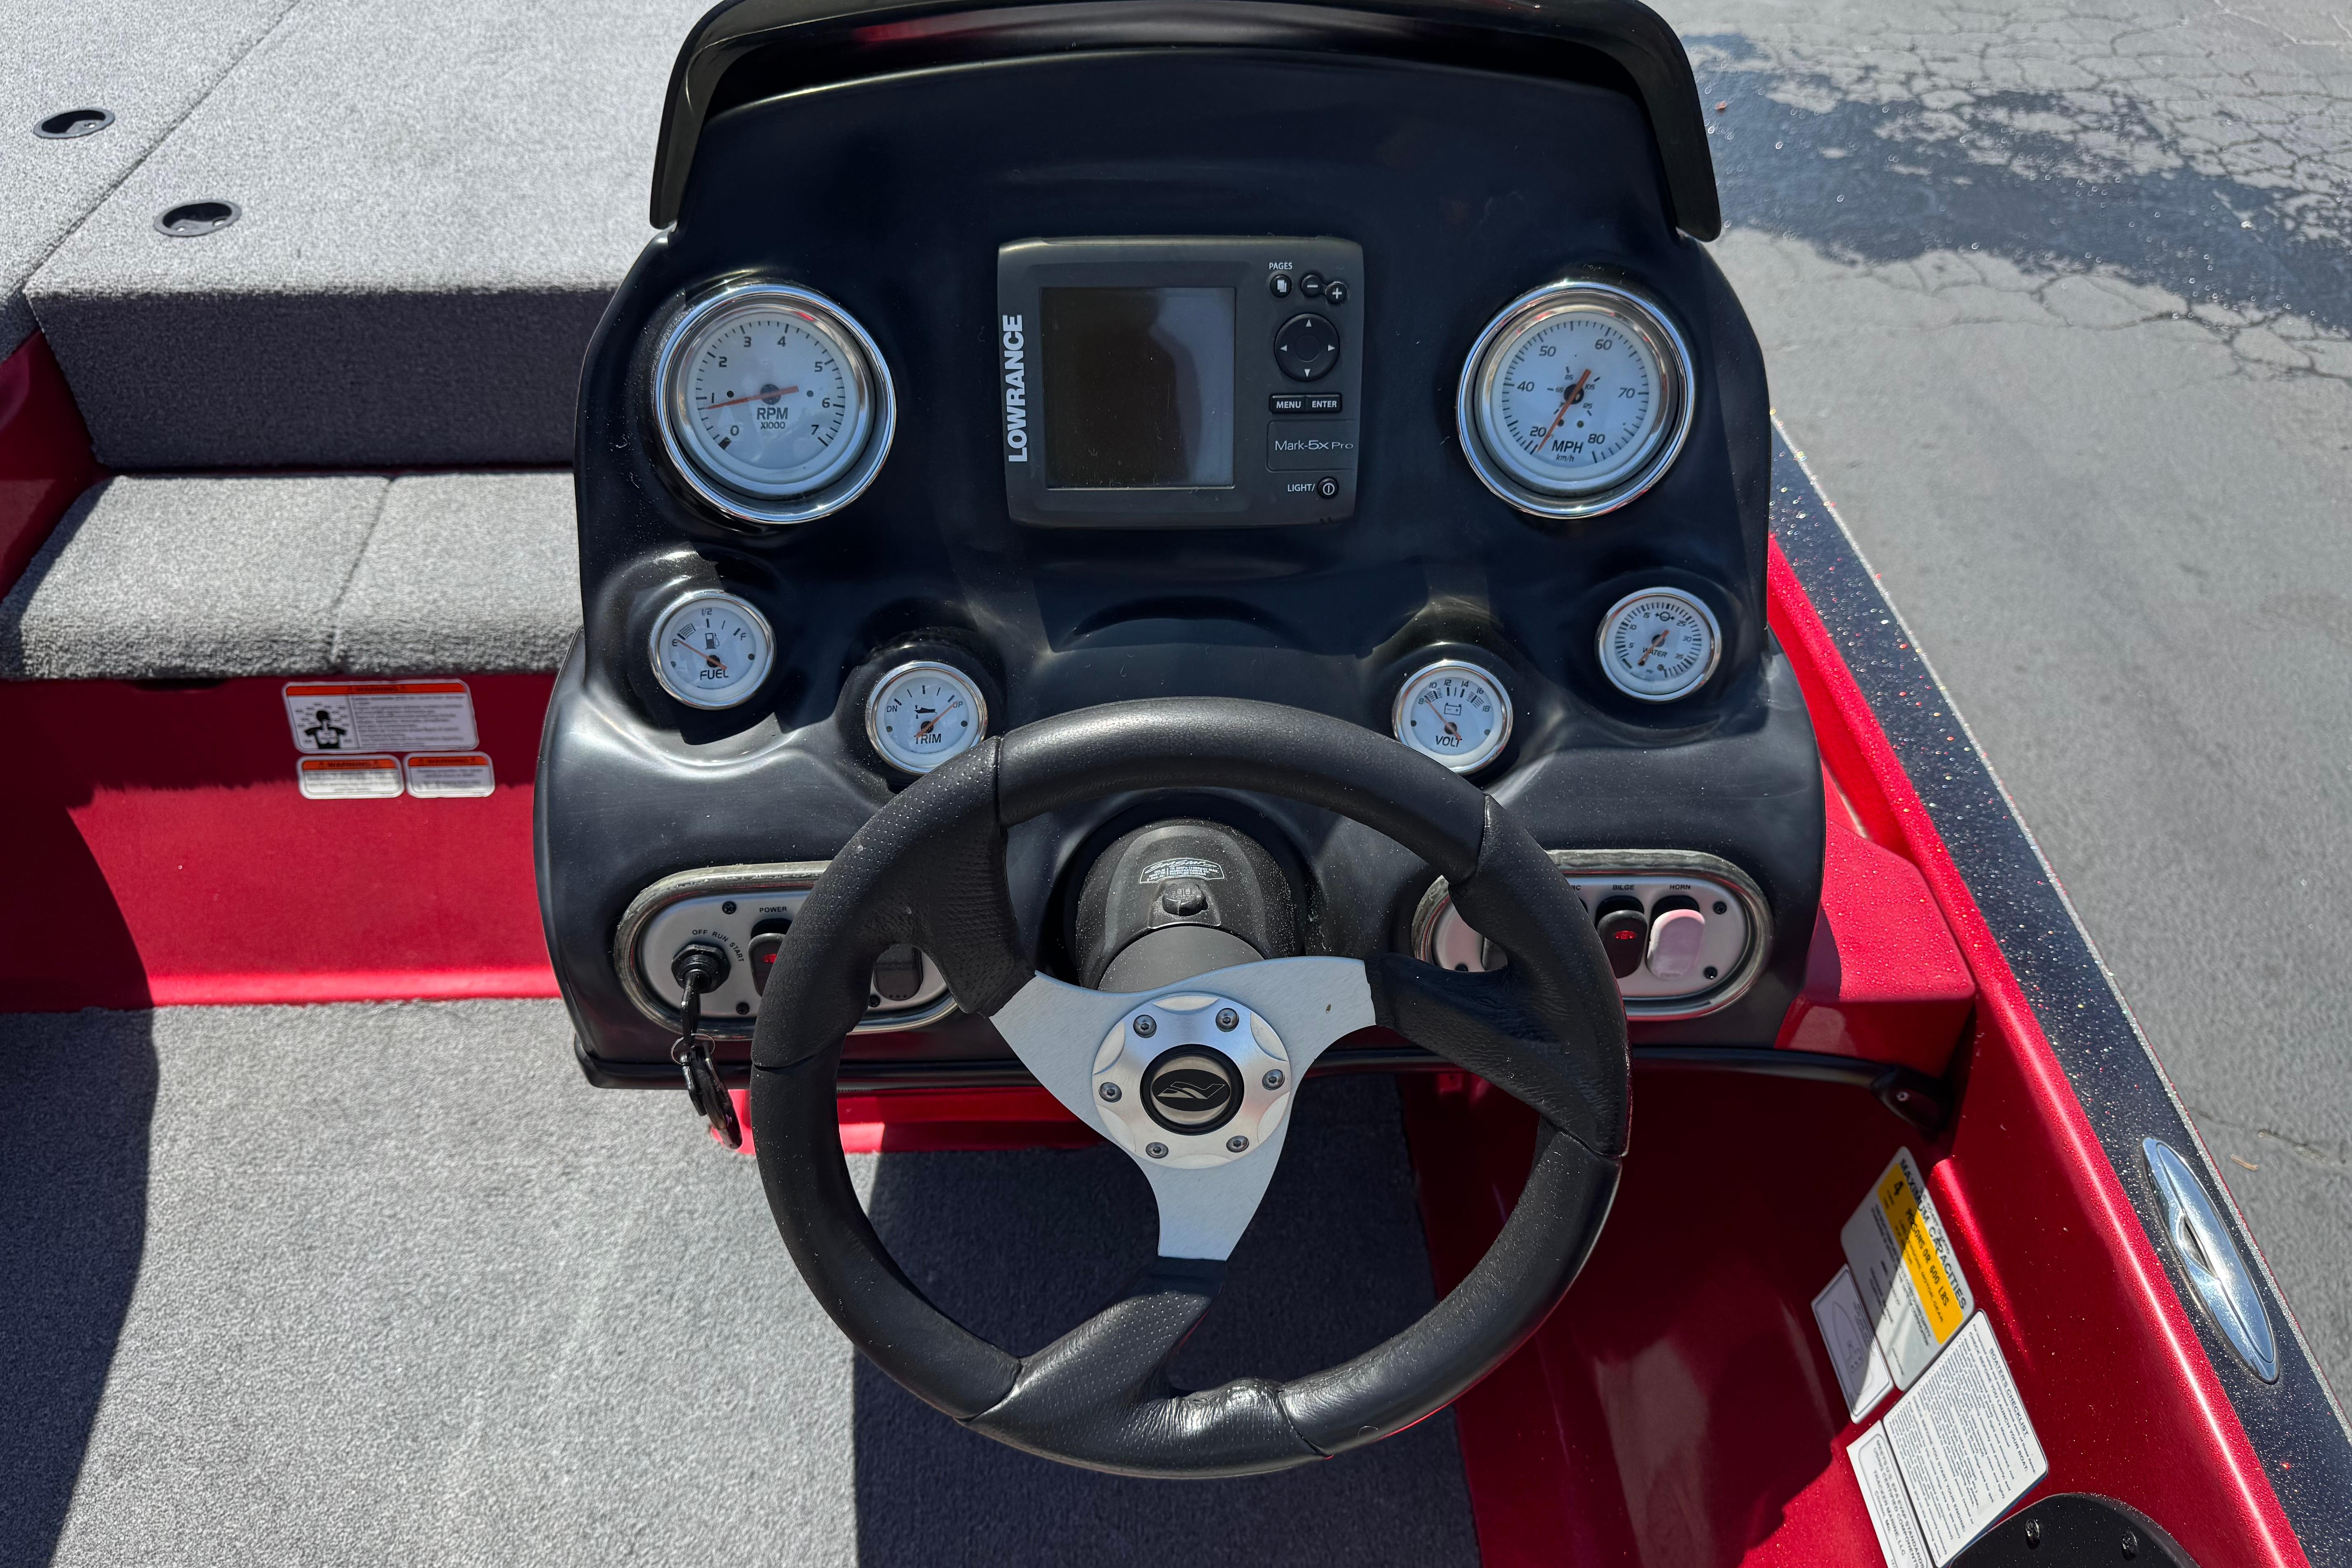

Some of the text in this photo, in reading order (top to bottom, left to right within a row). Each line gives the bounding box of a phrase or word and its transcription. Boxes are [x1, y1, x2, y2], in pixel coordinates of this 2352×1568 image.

[1269, 262, 1293, 270] PAGES
[743, 336, 751, 347] 3
[777, 336, 786, 347] 4
[1594, 340, 1612, 350] 60
[1538, 346, 1556, 357] 50
[718, 357, 727, 367] 2
[814, 362, 823, 373] 5
[1002, 314, 1028, 463] LOWRANCE
[1517, 381, 1535, 392] 40
[711, 393, 715, 403] 1
[1617, 388, 1635, 399] 70
[821, 398, 831, 408] 6
[756, 407, 789, 420] RPM
[730, 425, 740, 436] 0
[760, 421, 786, 429] X1000
[811, 425, 819, 435] 7
[1529, 427, 1547, 438] 20
[1587, 434, 1605, 445] 80
[1275, 440, 1329, 451] Mark-5x
[1551, 439, 1584, 454] MPH
[1556, 454, 1574, 462] km/h
[1288, 483, 1315, 492] LIGHT/
[701, 608, 712, 616] 1/2
[741, 632, 747, 641] F
[672, 639, 678, 647] E
[1642, 647, 1668, 658] WATER
[700, 669, 729, 680] FUEL
[914, 733, 942, 744] TRIM
[1435, 735, 1462, 747] VOLT
[712, 931, 729, 942] RUN
[729, 942, 744, 962] START
[1894, 1180, 1904, 1196] 4
[1898, 1158, 1930, 1224] MAXIMUM
[1927, 1225, 1968, 1310] CAPACITIES
[1904, 1207, 1950, 1307] PERSONS OR 600 LBS
[1969, 1330, 1980, 1356] CHECK
[1979, 1355, 1992, 1384] BEFORE
[1990, 1383, 1998, 1399] YOU
[1996, 1399, 2010, 1429] LAUNCH
[2009, 1429, 2019, 1450] YOUR
[1989, 1347, 2028, 1437] BOATER'S CHECKLIST
[1921, 1419, 1933, 1446] BEFORE
[1937, 1461, 1947, 1483] START
[1945, 1483, 1955, 1503] YOUR
[1881, 1472, 1899, 1512] CERTIFIED
[1890, 1482, 1899, 1499] EPA
[1897, 1499, 1907, 1519] EVAP
[1872, 1470, 1888, 1507] TRACKER
[1897, 1539, 1906, 1556] LLC
